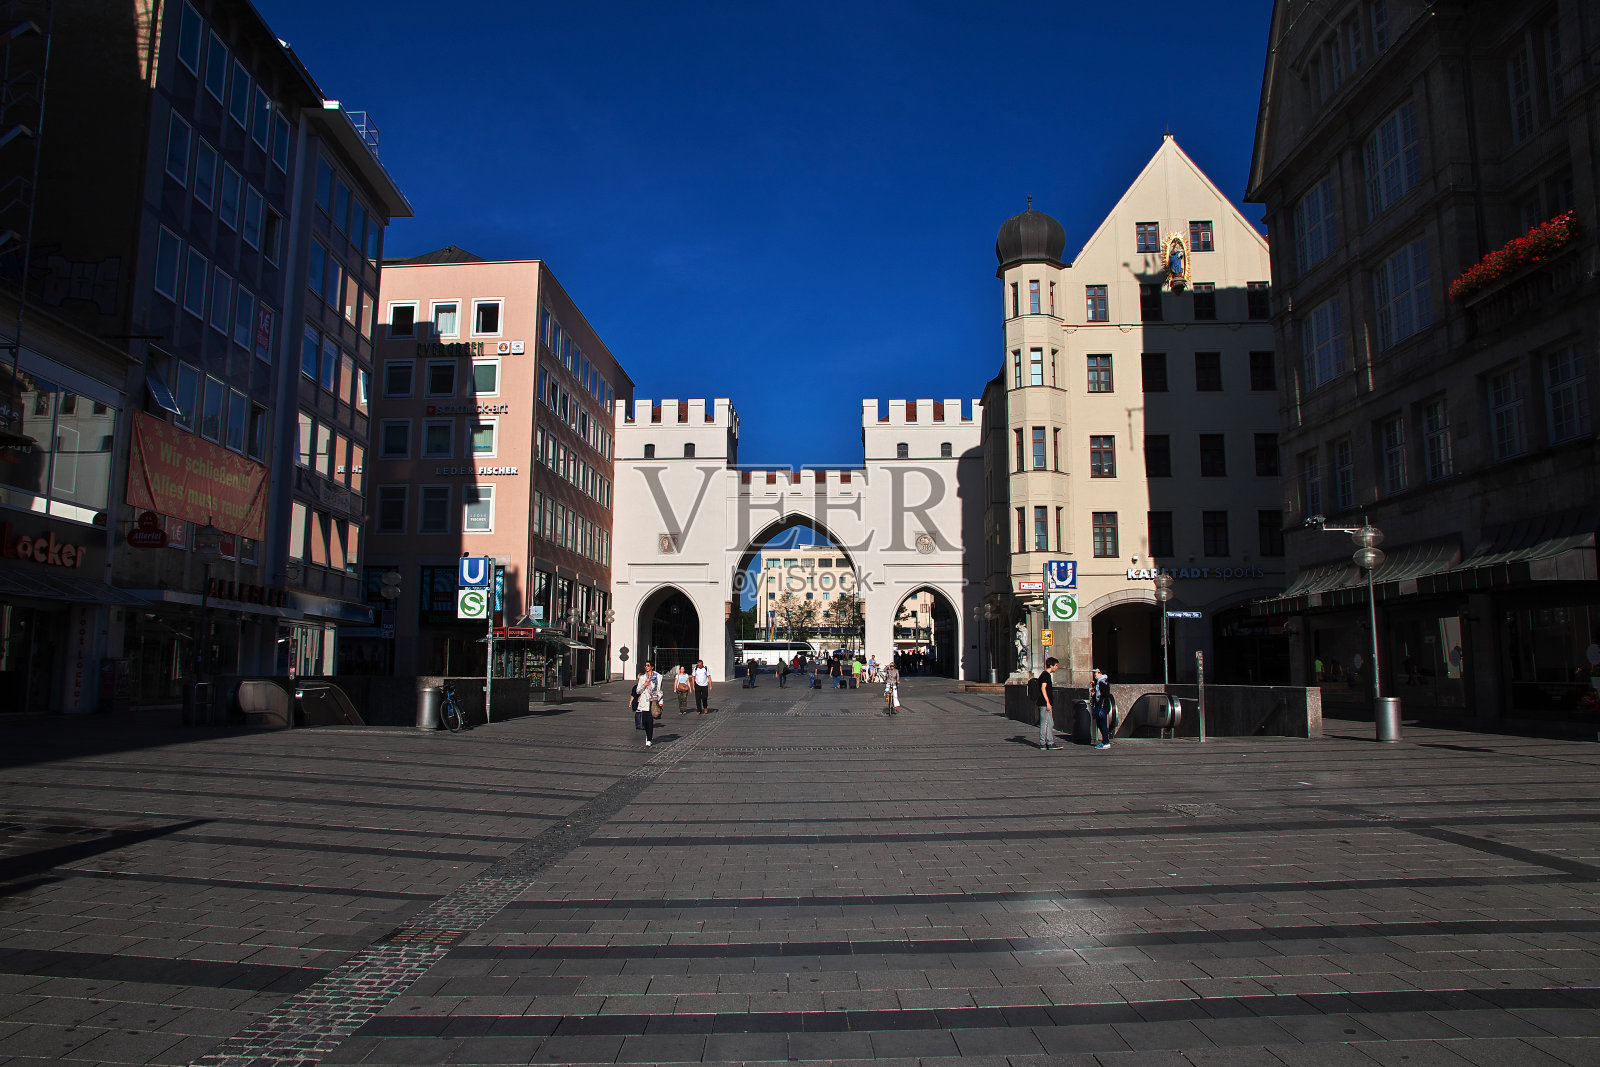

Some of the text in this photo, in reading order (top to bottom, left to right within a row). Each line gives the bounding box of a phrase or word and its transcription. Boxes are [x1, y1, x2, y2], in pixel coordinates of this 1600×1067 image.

[417, 342, 484, 356] EVERGREEN
[160, 441, 183, 468] Wir
[435, 467, 518, 475] LEDER FISCHER
[152, 472, 184, 500] Alles
[188, 488, 219, 512] muss
[2, 522, 87, 569] Locker
[462, 560, 485, 584] U
[1127, 564, 1264, 581] KARSTADT sports
[464, 594, 484, 615] S
[1055, 596, 1073, 618] S
